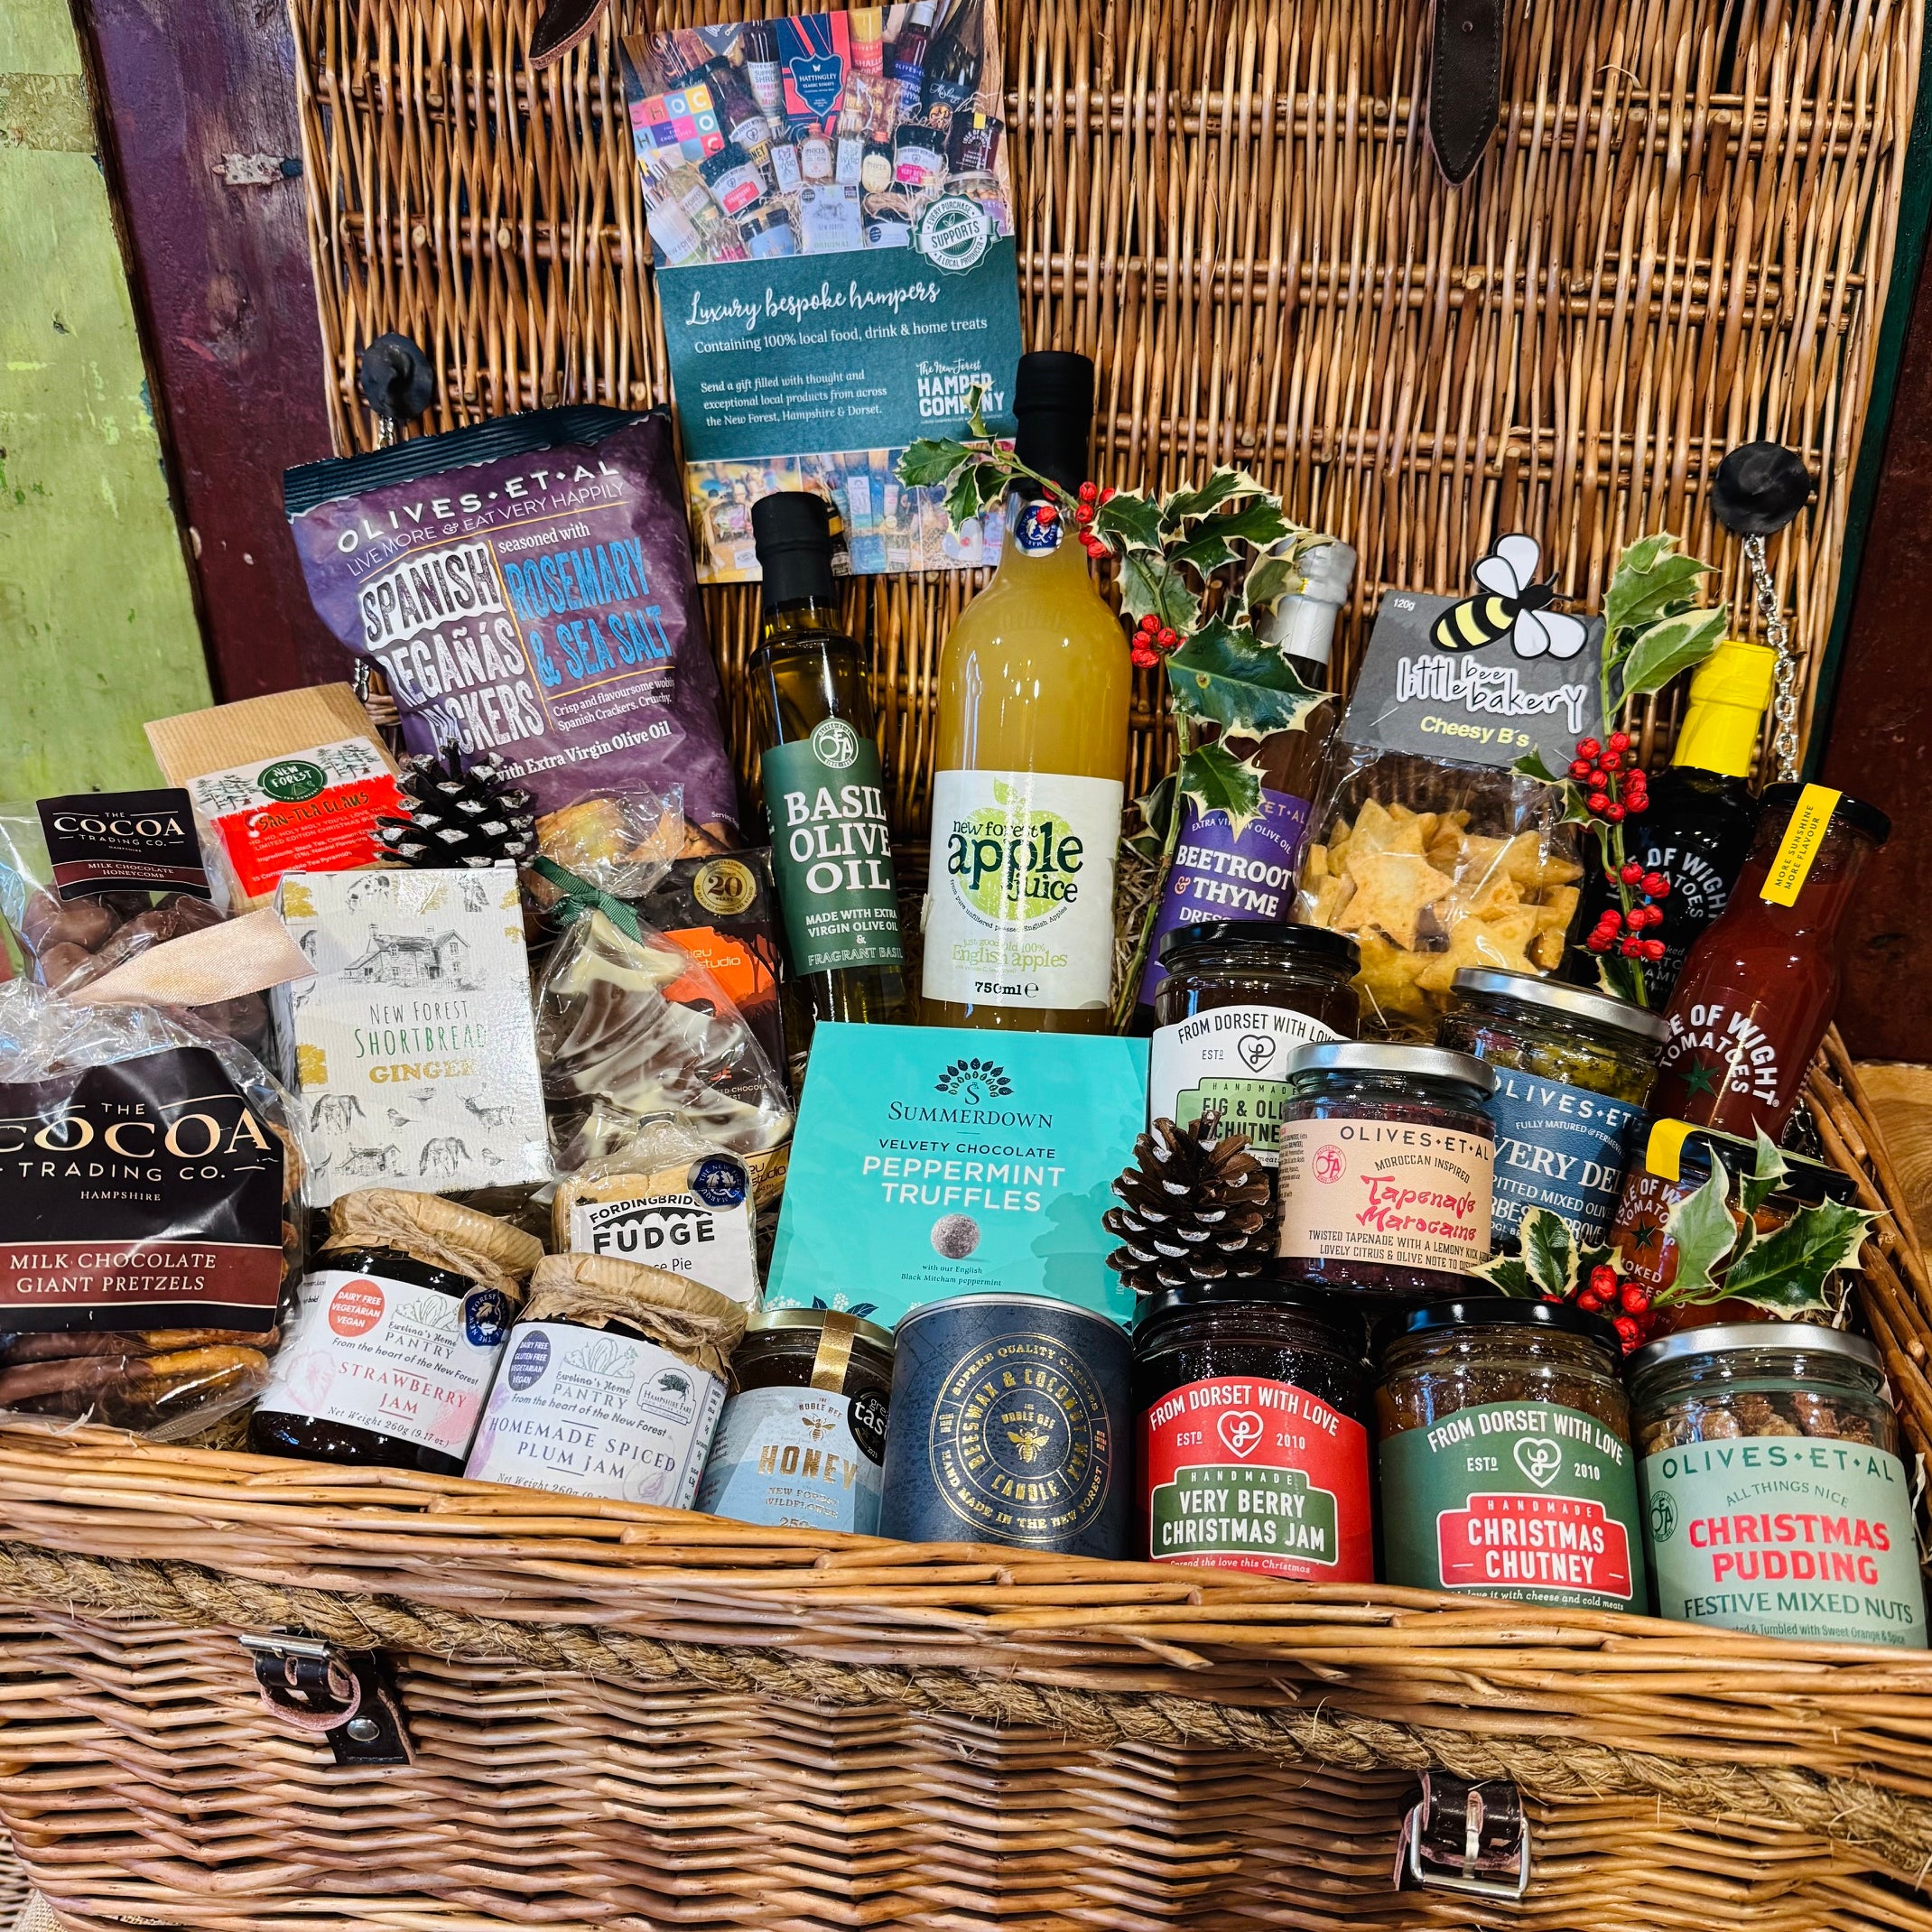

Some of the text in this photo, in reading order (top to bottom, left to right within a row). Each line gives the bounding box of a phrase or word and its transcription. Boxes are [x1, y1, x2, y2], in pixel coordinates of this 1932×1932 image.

[927, 201, 972, 226] EVERY PURCHASE
[932, 221, 980, 248] SUPPORTS
[941, 241, 984, 267] LOCAL PRODUCER
[685, 281, 941, 330] Luxury bespoke hampers
[695, 318, 988, 354] Containing 100% local food, drink & home treats
[701, 369, 865, 394] Send a gift filled with thought and
[703, 387, 887, 411] exceptional local products from across
[706, 405, 882, 427] the New Forest, Hampshire & Dorset.
[346, 481, 626, 578] LIVE MORE & EAT VERY HAPPILY
[498, 522, 590, 554] seasoned with
[504, 537, 652, 621] ROSEMARY
[362, 547, 501, 644] SPANISH
[1393, 599, 1416, 611] 120g
[529, 606, 673, 688] & SEA SALT
[1471, 672, 1584, 730] bakery
[1420, 716, 1496, 744] Cheesy
[272, 770, 312, 788] FOREST
[273, 766, 299, 777] NEW
[257, 792, 369, 831] SAN-TEA CLAUS
[784, 785, 887, 826] BASIL
[54, 816, 186, 837] COCOA
[79, 834, 167, 847] TRADING CO.
[789, 822, 891, 863] OLIVE
[948, 822, 1082, 890] apple
[1775, 804, 1814, 887] MORE SUNSHINE
[1784, 816, 1820, 890] MORE FLAVOUR
[88, 862, 174, 875] MILK CHOCOLATE
[103, 869, 165, 879] HONEYCOMB
[806, 859, 890, 894] OIL
[1175, 845, 1293, 890] BEETROOT
[708, 876, 742, 896] 20
[1007, 873, 1078, 903] juice
[1175, 877, 1279, 917] & THYME
[806, 908, 897, 925] MADE WITH EXTRA
[1178, 1013, 1306, 1045] FROM DORSET WITH
[368, 1059, 477, 1082] GINGER
[1658, 1031, 1750, 1094] TOMATOES
[887, 1101, 1054, 1129] SUMMERDOWN
[879, 1139, 1056, 1159] VELVETY CHOCOLATE
[862, 1156, 1065, 1186] PEPPERMINT
[1375, 1155, 1471, 1184] MOROCCAN INSPIRED
[80, 1191, 161, 1201] HAMPSHIRE
[881, 1182, 1041, 1212] TRUFFLES
[1360, 1175, 1476, 1219] Tapenade
[593, 1220, 715, 1254] FUDGE
[1356, 1206, 1477, 1241] Marocaine
[1308, 1230, 1463, 1256] TWISTED TAPENADE WITH A LEMONY
[17, 1276, 205, 1293] GIANT PRETZELS
[922, 1264, 938, 1272] with
[955, 1265, 982, 1276] English
[331, 1303, 381, 1317] VEGETARIAN
[338, 1291, 382, 1305] DAIRY FREE
[337, 1316, 366, 1328] VEGAN
[332, 1338, 478, 1386] From the heart of the New Forest
[998, 1344, 1055, 1360] QUALITY
[339, 1361, 467, 1407] STRAWBERRY
[379, 1393, 418, 1414] JAM
[1150, 1385, 1340, 1436] FROM DORSET WITH LOVE
[489, 1417, 675, 1472] HOMEMADE SPICED
[1276, 1434, 1306, 1449] 2010
[517, 1442, 625, 1479] PLUM JAM
[758, 1445, 858, 1490] HONEY
[1192, 1472, 1294, 1484] HANDMADE
[1179, 1490, 1305, 1518] VERY BERRY
[1726, 1481, 1849, 1508] ALL THINGS NICE
[1162, 1519, 1324, 1551] CHRISTMAS JAM
[1468, 1518, 1604, 1554] CHRISTMAS
[1689, 1513, 1890, 1552] CHRISTMAS
[1485, 1550, 1594, 1584] CHUTNEY
[1712, 1550, 1879, 1586] PUDDING
[1527, 1591, 1624, 1611] cheese and cold meats
[1684, 1592, 1913, 1624] FESTIVE MIXED NUTS
